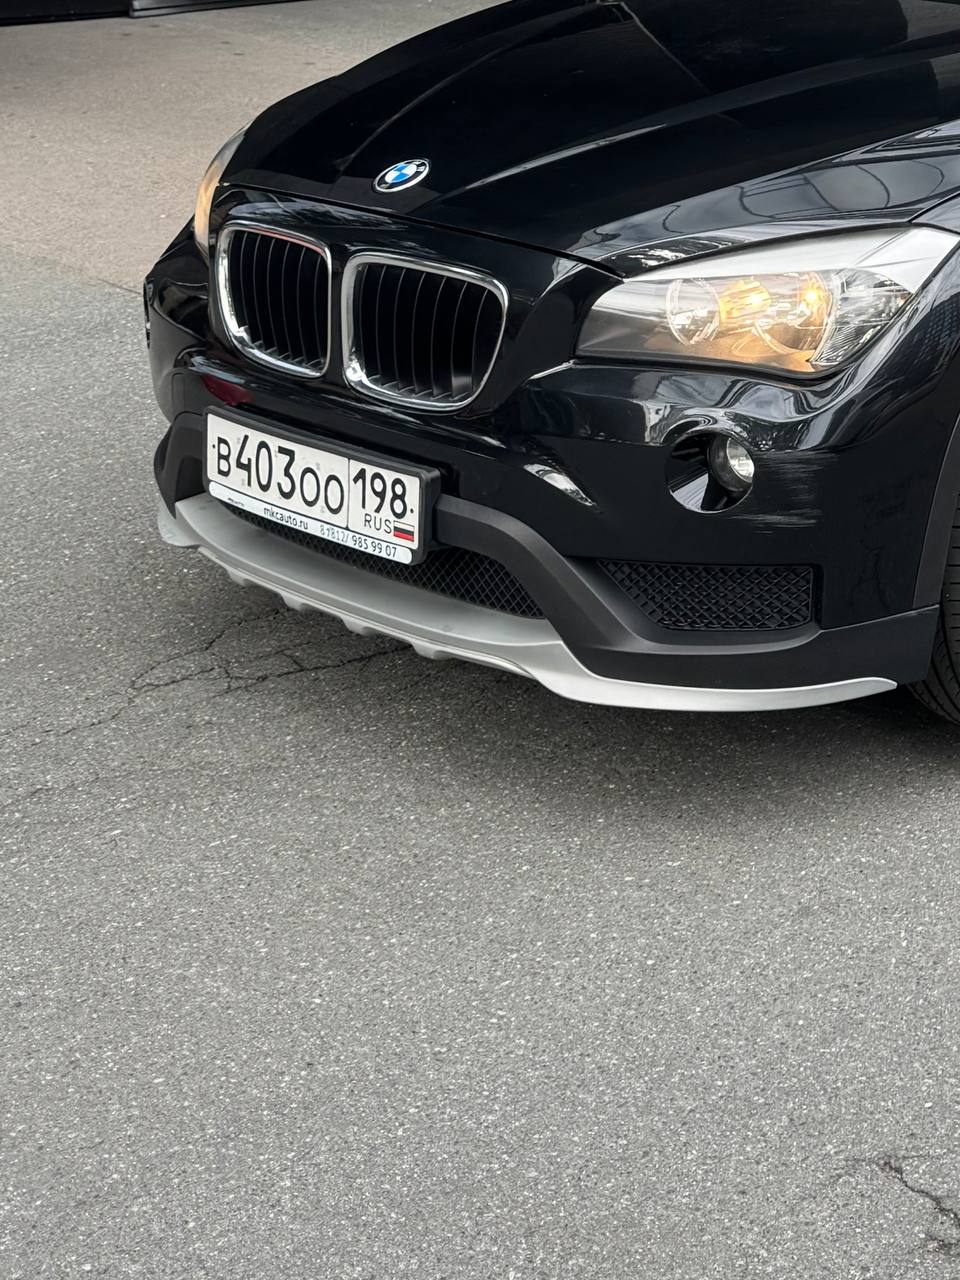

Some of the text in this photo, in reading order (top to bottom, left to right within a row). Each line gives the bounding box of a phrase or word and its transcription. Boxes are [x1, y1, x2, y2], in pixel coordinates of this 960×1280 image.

[352, 467, 408, 520] 198
[364, 513, 392, 534] RUS
[351, 535, 369, 550] 985
[371, 541, 383, 554] 99
[385, 546, 397, 558] 07
